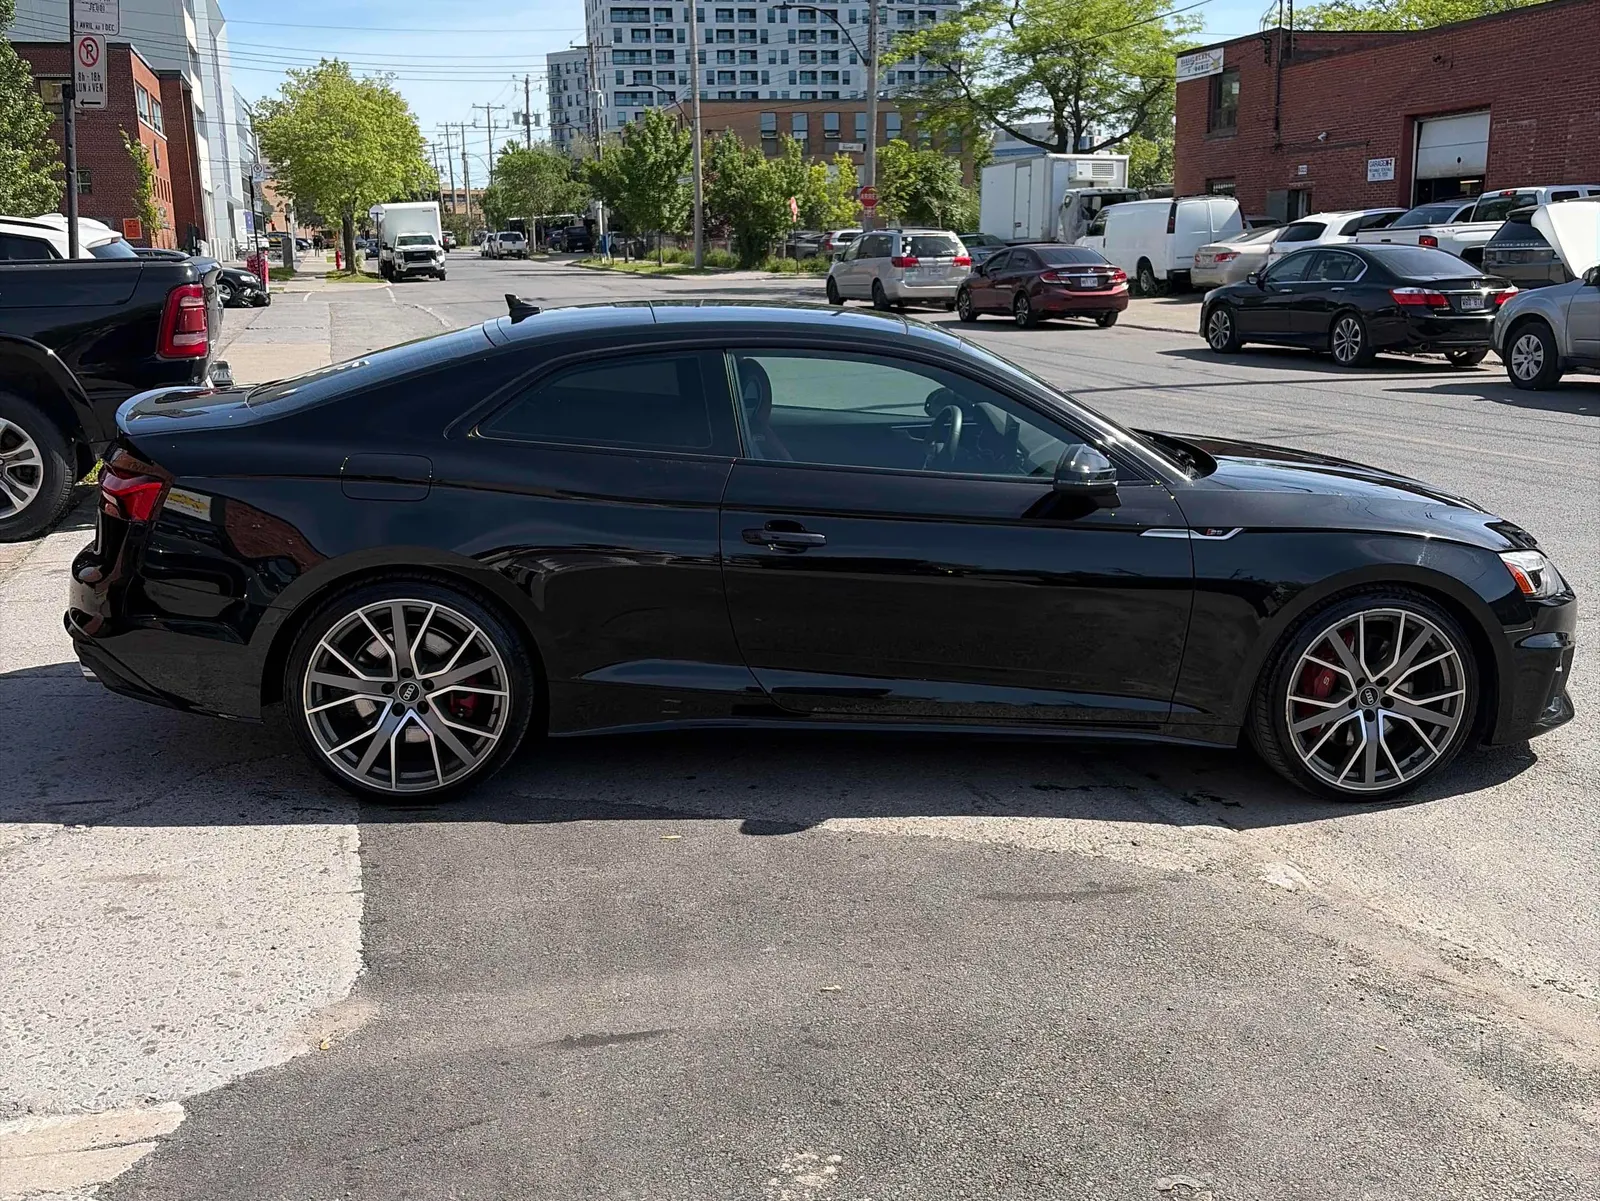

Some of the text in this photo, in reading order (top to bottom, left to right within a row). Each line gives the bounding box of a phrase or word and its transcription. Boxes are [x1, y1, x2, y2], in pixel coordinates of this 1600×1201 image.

[80, 22, 94, 30] AVRIL
[78, 72, 86, 81] 8h
[91, 72, 101, 81] 18h
[75, 83, 87, 92] LUN
[92, 83, 104, 92] VEN
